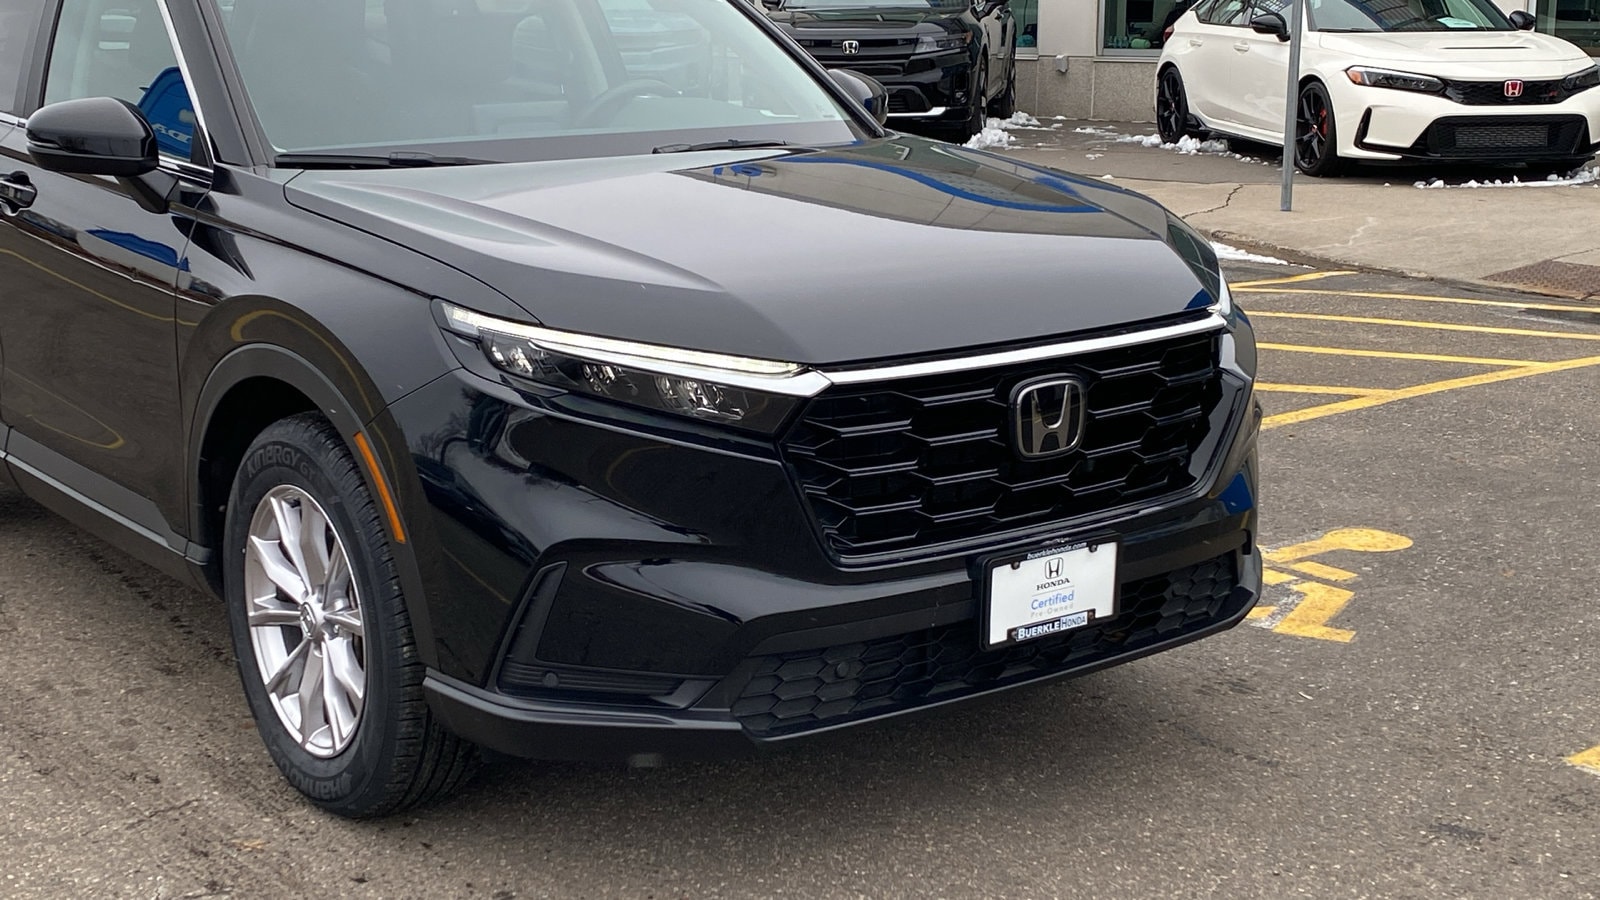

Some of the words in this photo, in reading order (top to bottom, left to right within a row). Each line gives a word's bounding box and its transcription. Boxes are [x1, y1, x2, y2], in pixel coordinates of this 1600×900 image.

[1026, 541, 1087, 560] buerklehonda.com
[1036, 577, 1070, 591] HONDA
[1030, 590, 1075, 610] Certified
